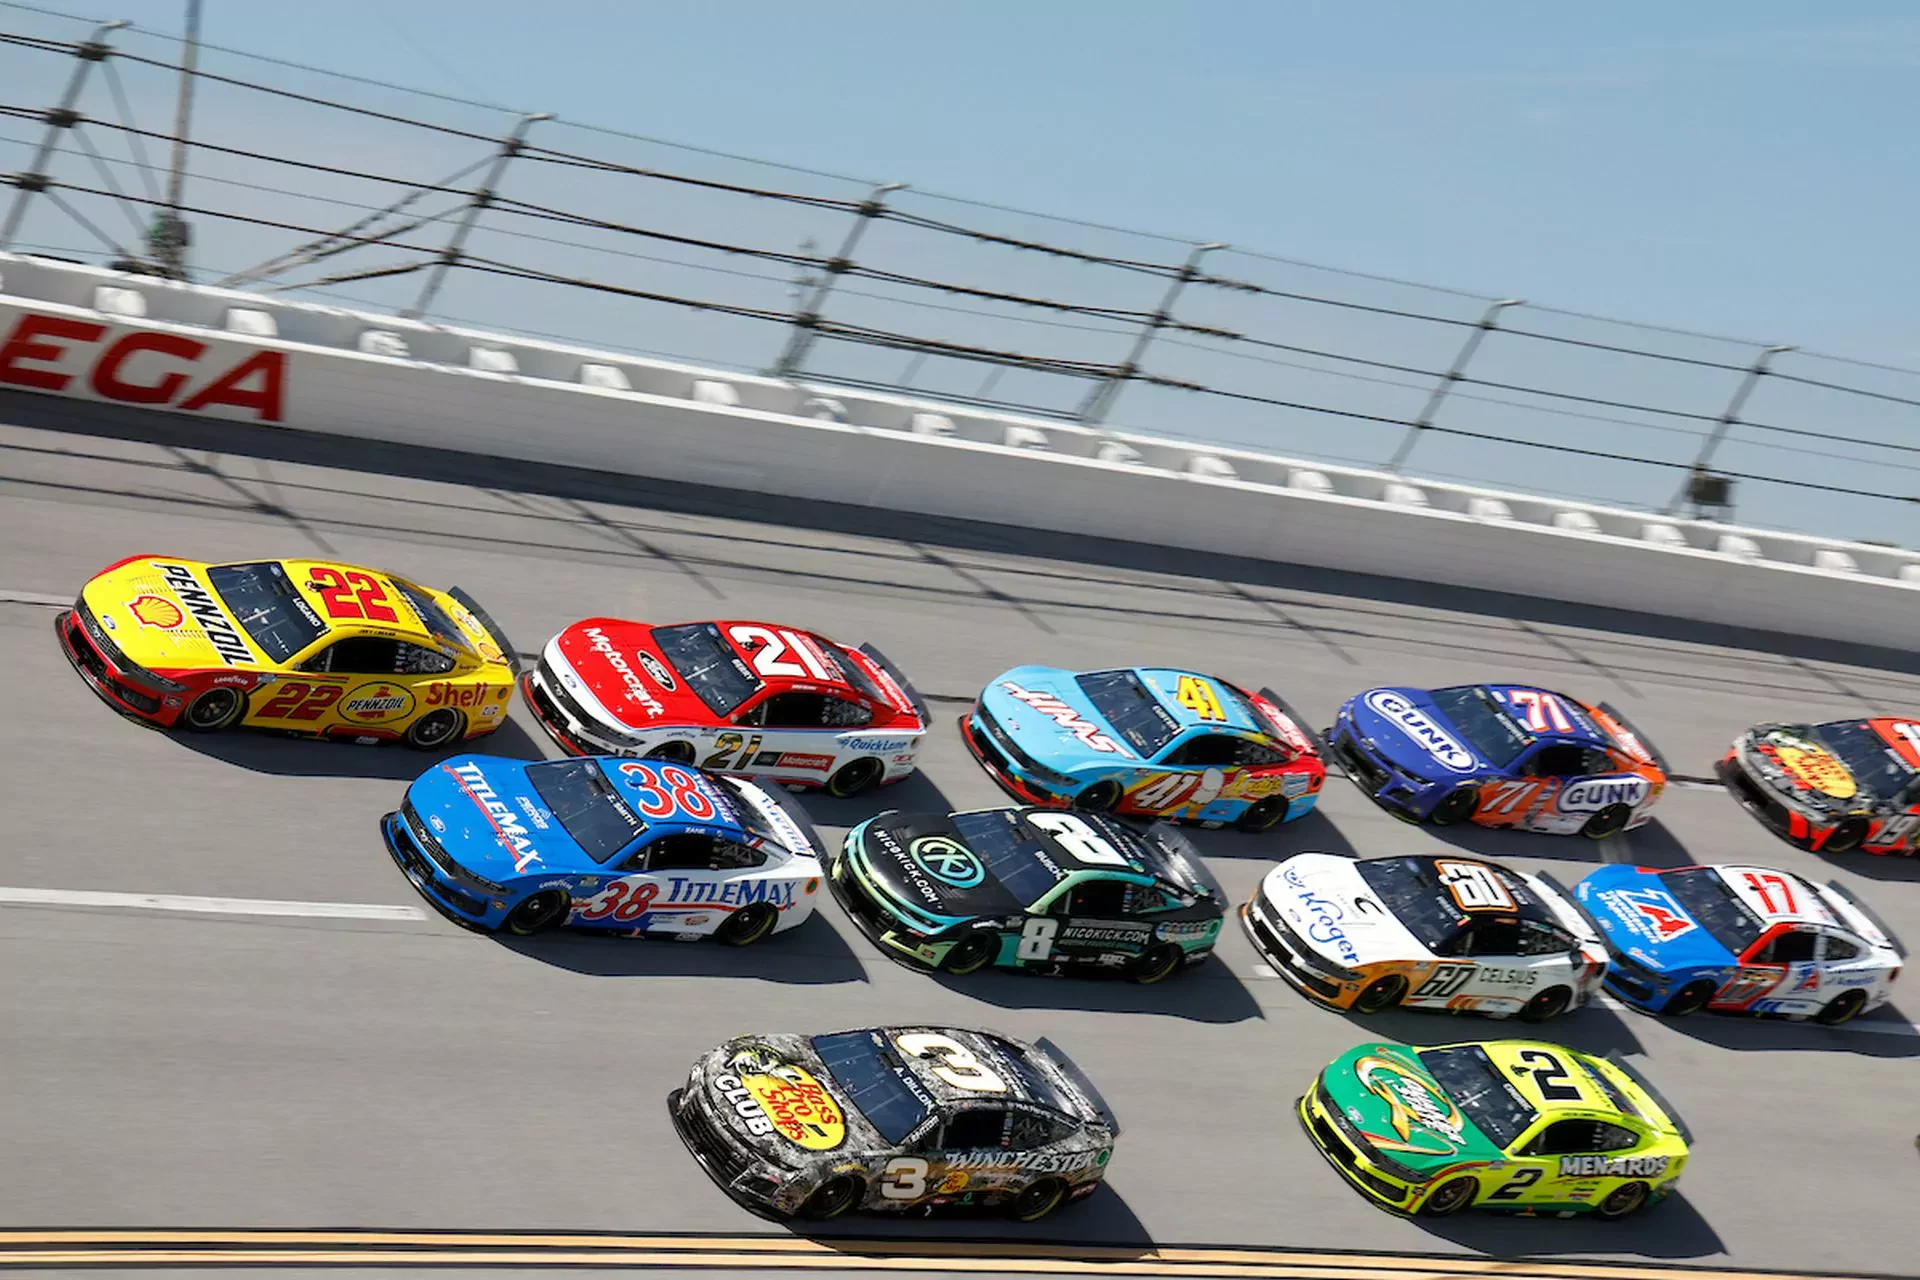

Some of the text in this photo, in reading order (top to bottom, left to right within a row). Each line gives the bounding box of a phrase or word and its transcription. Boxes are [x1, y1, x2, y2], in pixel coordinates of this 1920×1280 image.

[0, 313, 289, 422] EGA
[151, 563, 256, 667] PENNZOIL
[292, 597, 321, 627] LOGANO
[308, 567, 400, 623] 22
[583, 627, 664, 718] Motorcraft
[728, 626, 831, 682] 21
[731, 658, 755, 681] BERRY
[254, 682, 344, 721] 22
[346, 695, 406, 712] PENNZOIL
[425, 682, 488, 707] Shell
[1176, 675, 1228, 722] 41
[1507, 690, 1575, 733] 71
[998, 682, 1137, 760] HAAS
[1381, 698, 1462, 760] GUNK
[701, 732, 763, 770] 21
[782, 755, 829, 768] Motorcraft
[850, 737, 884, 751] Quick
[619, 762, 716, 820] 38
[1134, 771, 1200, 810] 41
[1481, 781, 1538, 814] 71
[1567, 781, 1641, 805] GUNK
[616, 802, 637, 826] SMITH
[1866, 815, 1919, 845] 19
[1026, 812, 1130, 867] 8
[873, 829, 940, 904] NICOKICK.COM
[1034, 850, 1062, 880] BUSCH
[1437, 861, 1515, 909] 60
[581, 881, 660, 922] 38
[1742, 873, 1798, 914] 17
[1016, 917, 1059, 960] 8
[1062, 927, 1150, 945] NICOKICK.COM
[1298, 892, 1360, 963] Kroger
[1411, 963, 1478, 998] 60
[1479, 967, 1538, 985] CELSIUS
[896, 1033, 1008, 1092] 3
[1520, 1050, 1584, 1101] 2
[714, 1073, 774, 1137] CLUB
[777, 1083, 813, 1118] Pro
[797, 1082, 838, 1125] Bass
[902, 1075, 936, 1110] DILLON
[1503, 1082, 1533, 1112] CINDRIC
[758, 1087, 809, 1141] Shops
[880, 1156, 929, 1200] 3
[944, 1149, 1096, 1174] WINCHESTER
[1559, 1155, 1668, 1177] MENARDS
[1488, 1168, 1544, 1200] 2
